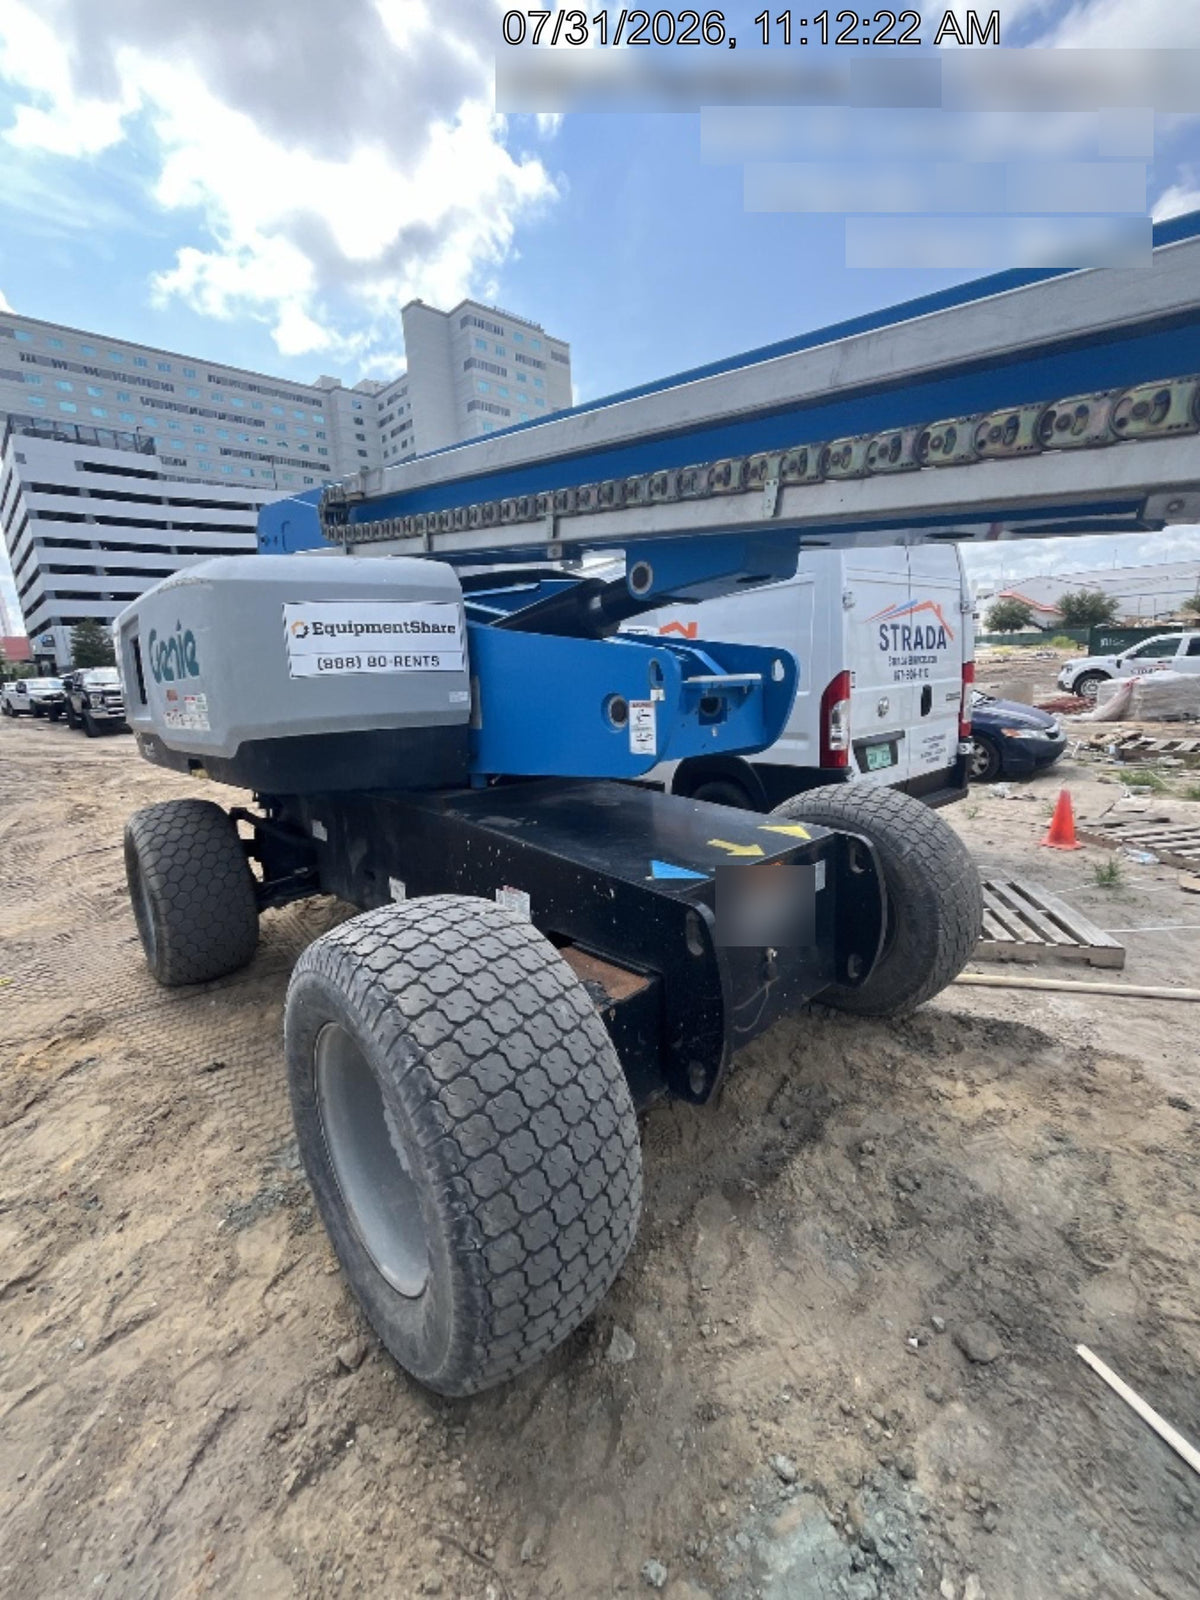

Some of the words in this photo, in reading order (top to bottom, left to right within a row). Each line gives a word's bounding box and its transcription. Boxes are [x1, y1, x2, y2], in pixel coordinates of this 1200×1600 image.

[312, 620, 456, 637] EquipmentShare
[879, 623, 947, 651] STRADA
[149, 619, 200, 684] Genie
